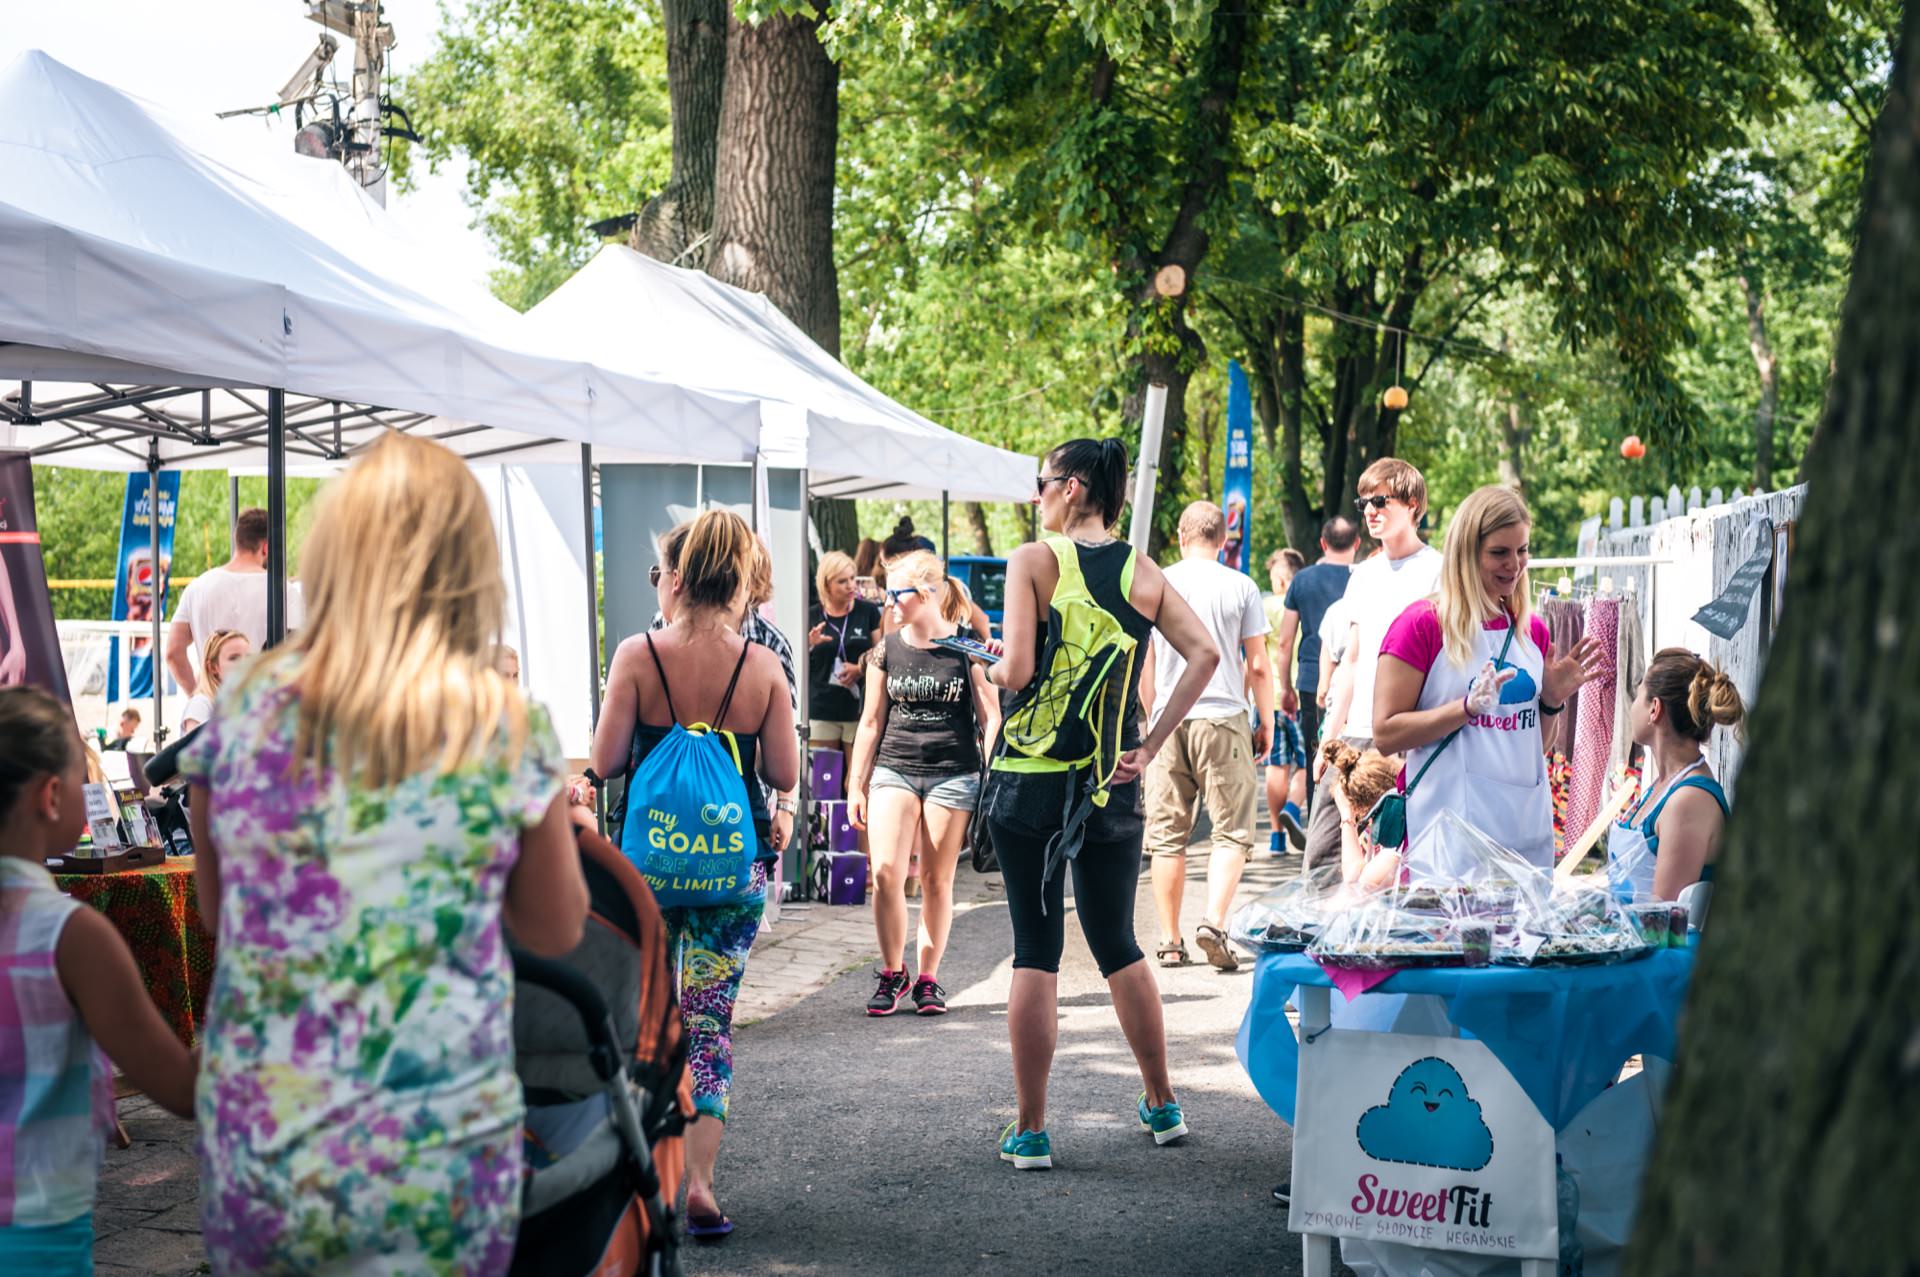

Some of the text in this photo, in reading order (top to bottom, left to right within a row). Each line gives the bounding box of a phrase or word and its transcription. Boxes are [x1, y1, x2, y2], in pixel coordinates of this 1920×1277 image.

[648, 808, 678, 832] my
[648, 827, 744, 854] GOALS
[644, 851, 742, 875] ARE NOT
[672, 875, 737, 891] LIMITS
[1351, 1173, 1493, 1228] SweetFit
[1304, 1211, 1363, 1231] ZDROWE
[1376, 1221, 1434, 1240] SŁODYCZE
